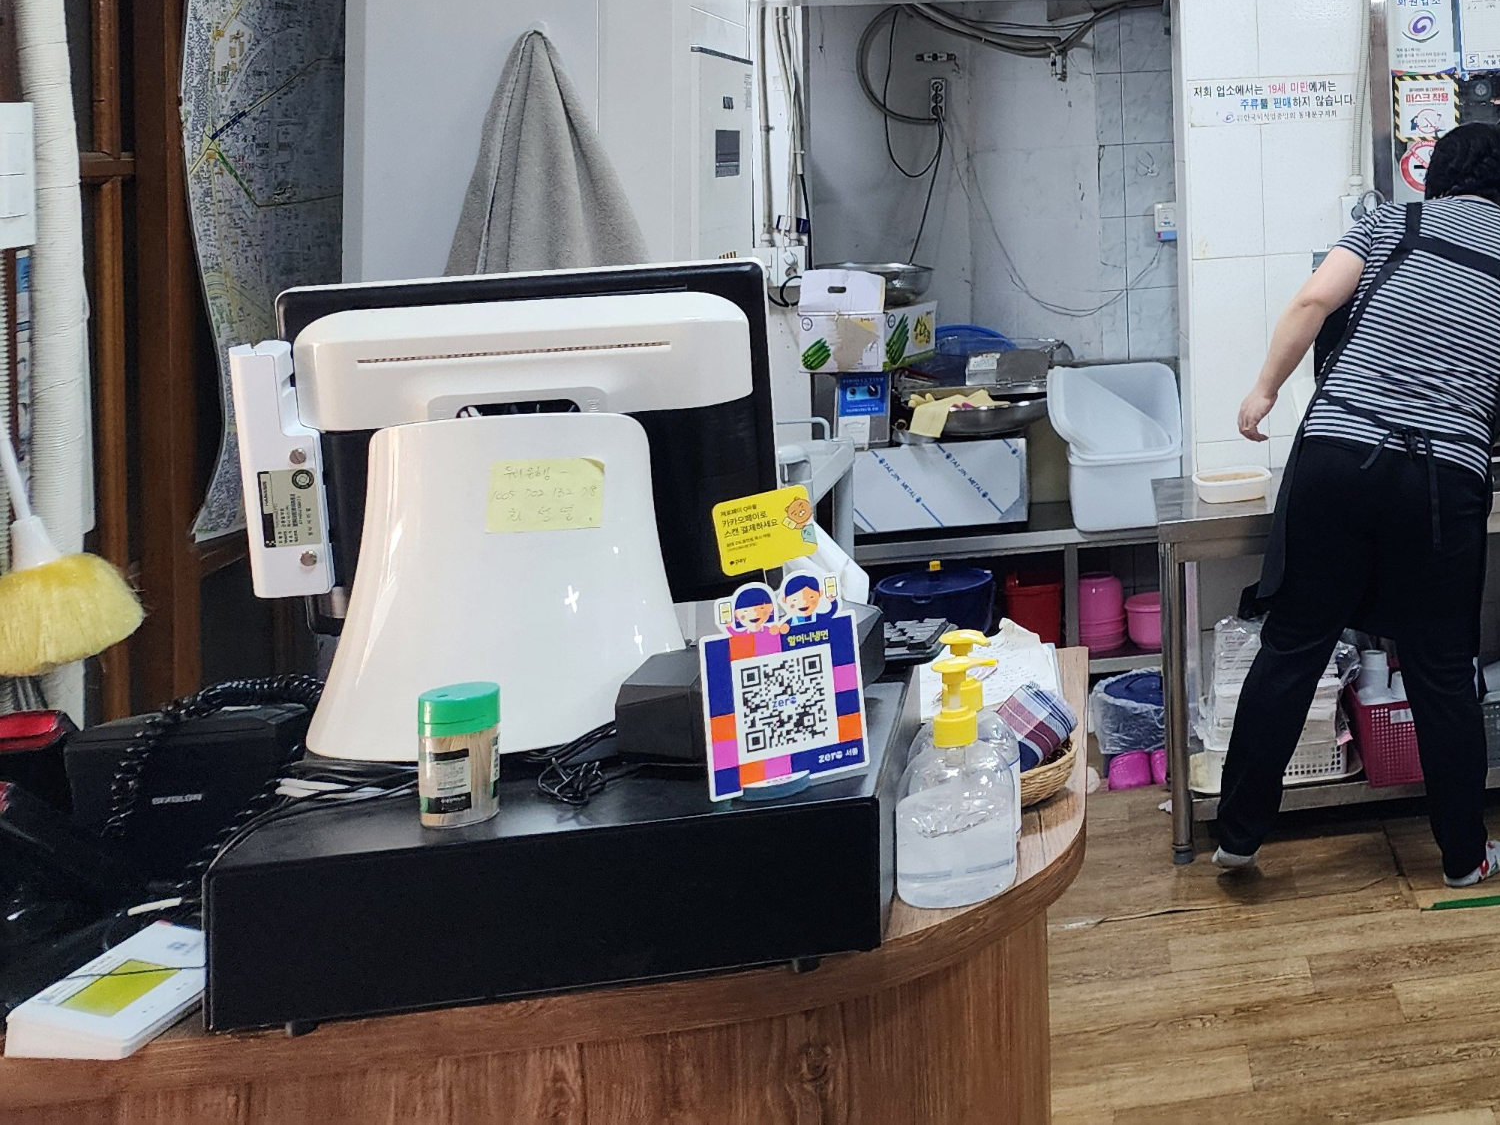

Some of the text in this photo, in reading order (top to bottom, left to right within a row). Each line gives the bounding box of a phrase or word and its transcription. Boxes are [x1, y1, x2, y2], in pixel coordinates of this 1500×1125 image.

[1193, 80, 1337, 98] 저희 업소에서는 19세 미만에게는
[1240, 93, 1356, 111] 주류를 판매하지 않습니다.
[1406, 93, 1449, 103] 마스크 착용
[901, 481, 916, 499] METAL
[968, 477, 983, 493] METAL
[720, 507, 743, 517] 제로페이
[722, 511, 768, 527] 카카오페이로
[724, 519, 778, 539] 스캔 결제하세요
[787, 629, 829, 647] 할머니냉면
[772, 696, 797, 709] zero
[818, 749, 843, 763] zero
